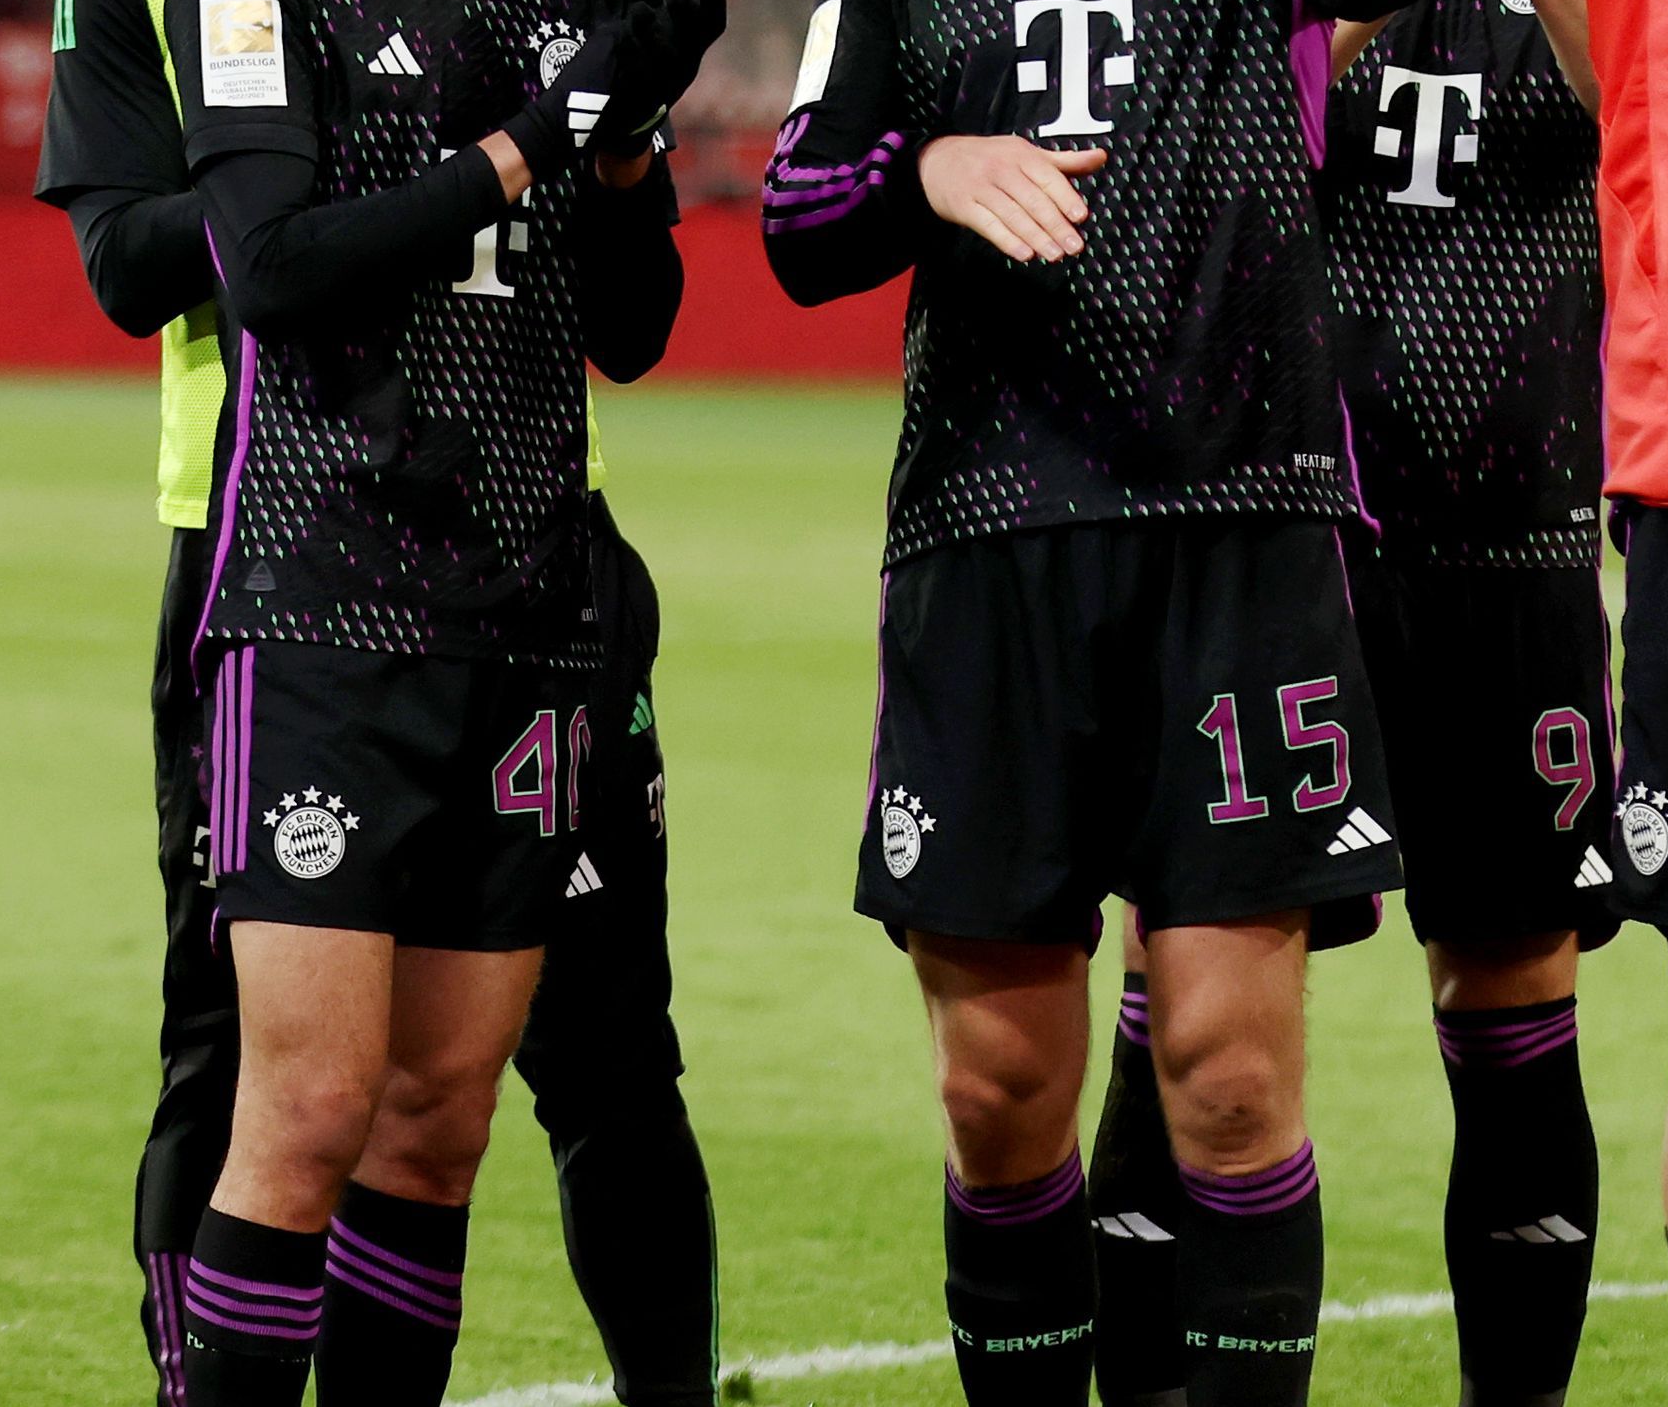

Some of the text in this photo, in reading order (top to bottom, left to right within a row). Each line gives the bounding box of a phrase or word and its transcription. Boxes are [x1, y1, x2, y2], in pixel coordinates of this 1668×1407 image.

[209, 57, 277, 71] BUNDESLIGA
[1374, 65, 1482, 208] T
[1197, 675, 1352, 824] 15
[1533, 706, 1596, 831] 9
[282, 813, 339, 839] FC BAYERN
[986, 1319, 1094, 1353] BAYERN
[1186, 1329, 1314, 1353] FC BAYERN
